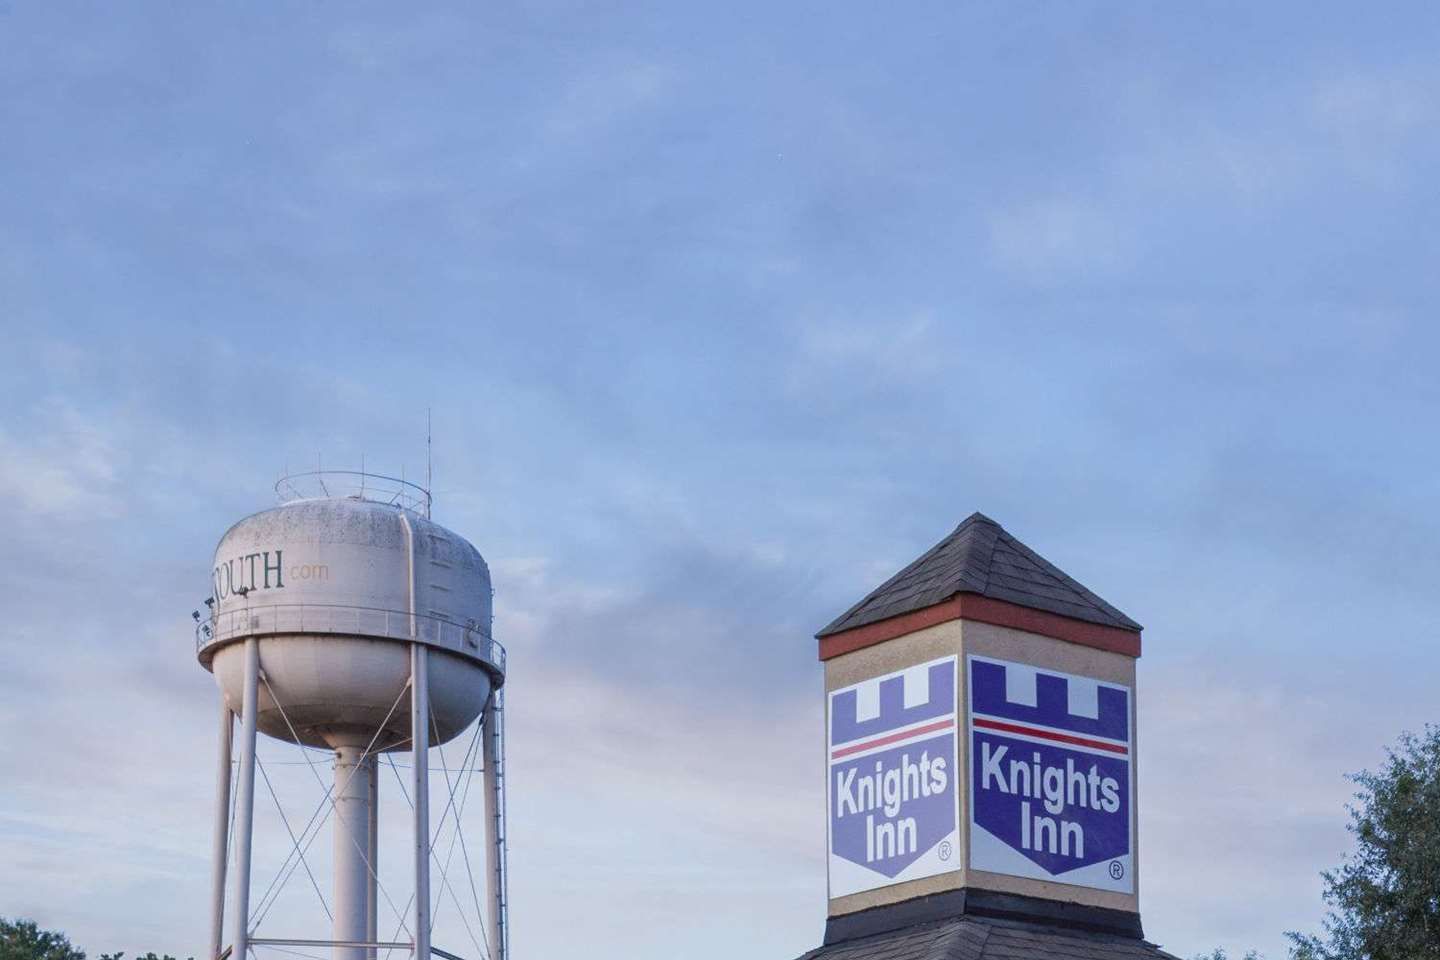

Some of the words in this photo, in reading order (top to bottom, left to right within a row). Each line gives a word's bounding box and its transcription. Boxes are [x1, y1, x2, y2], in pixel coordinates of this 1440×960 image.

[837, 750, 948, 818] Knights
[982, 742, 1120, 815] Knights
[866, 815, 917, 862] Inn
[1021, 801, 1084, 859] Inn
